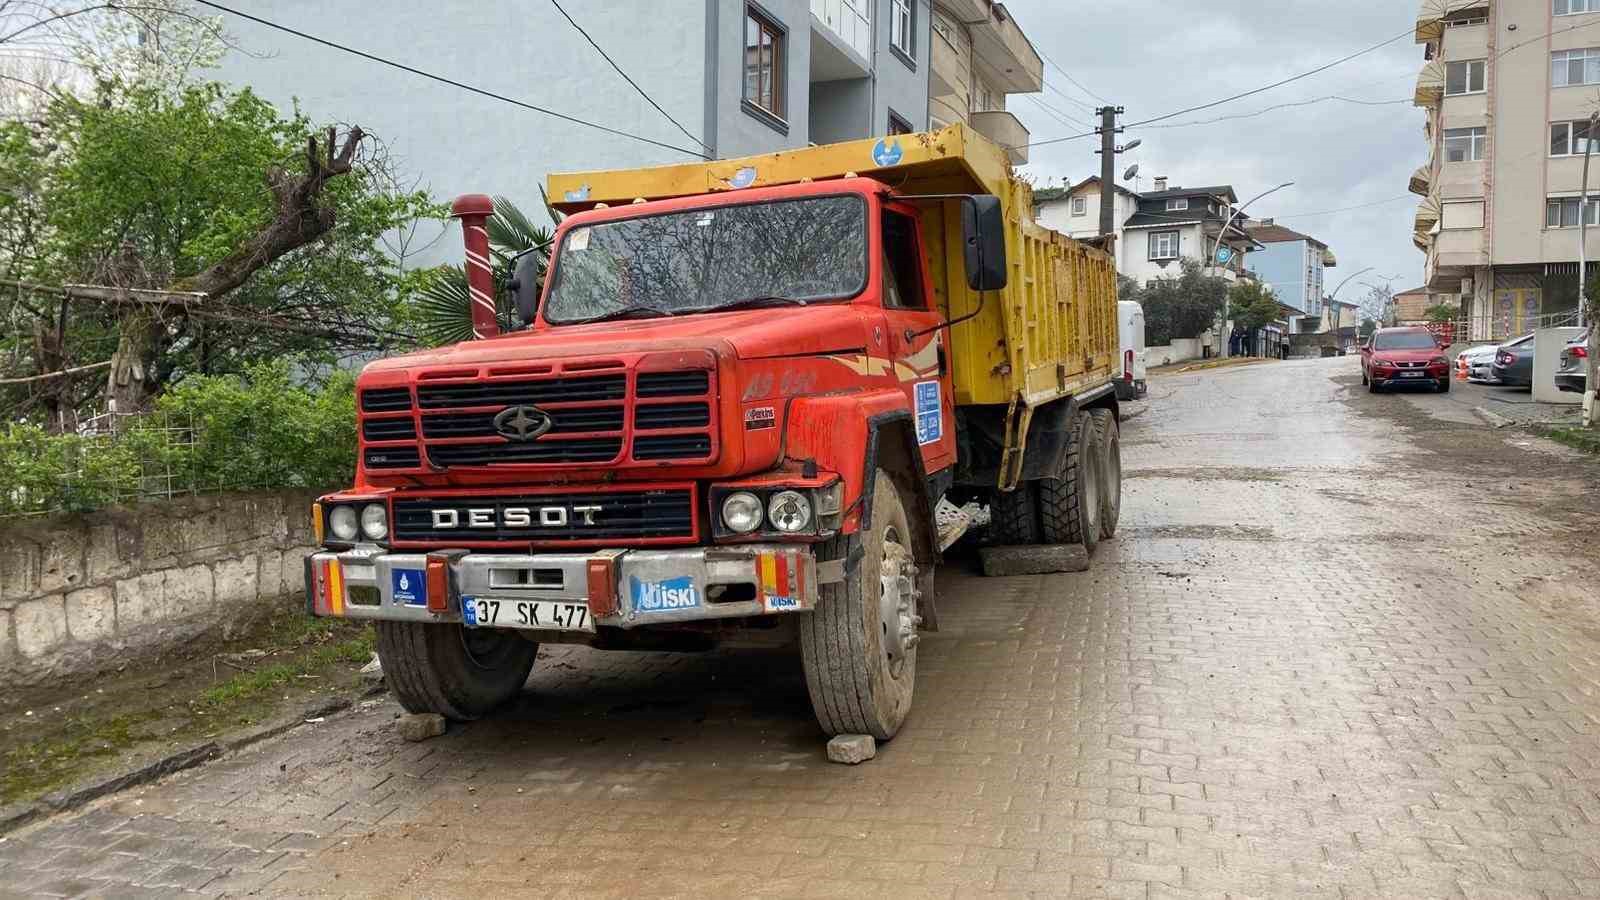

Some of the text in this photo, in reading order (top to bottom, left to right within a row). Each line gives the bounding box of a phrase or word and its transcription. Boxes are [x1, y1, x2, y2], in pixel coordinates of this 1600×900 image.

[431, 505, 602, 529] DESOT
[466, 613, 476, 624] TR
[478, 600, 587, 628] 37 SK 477
